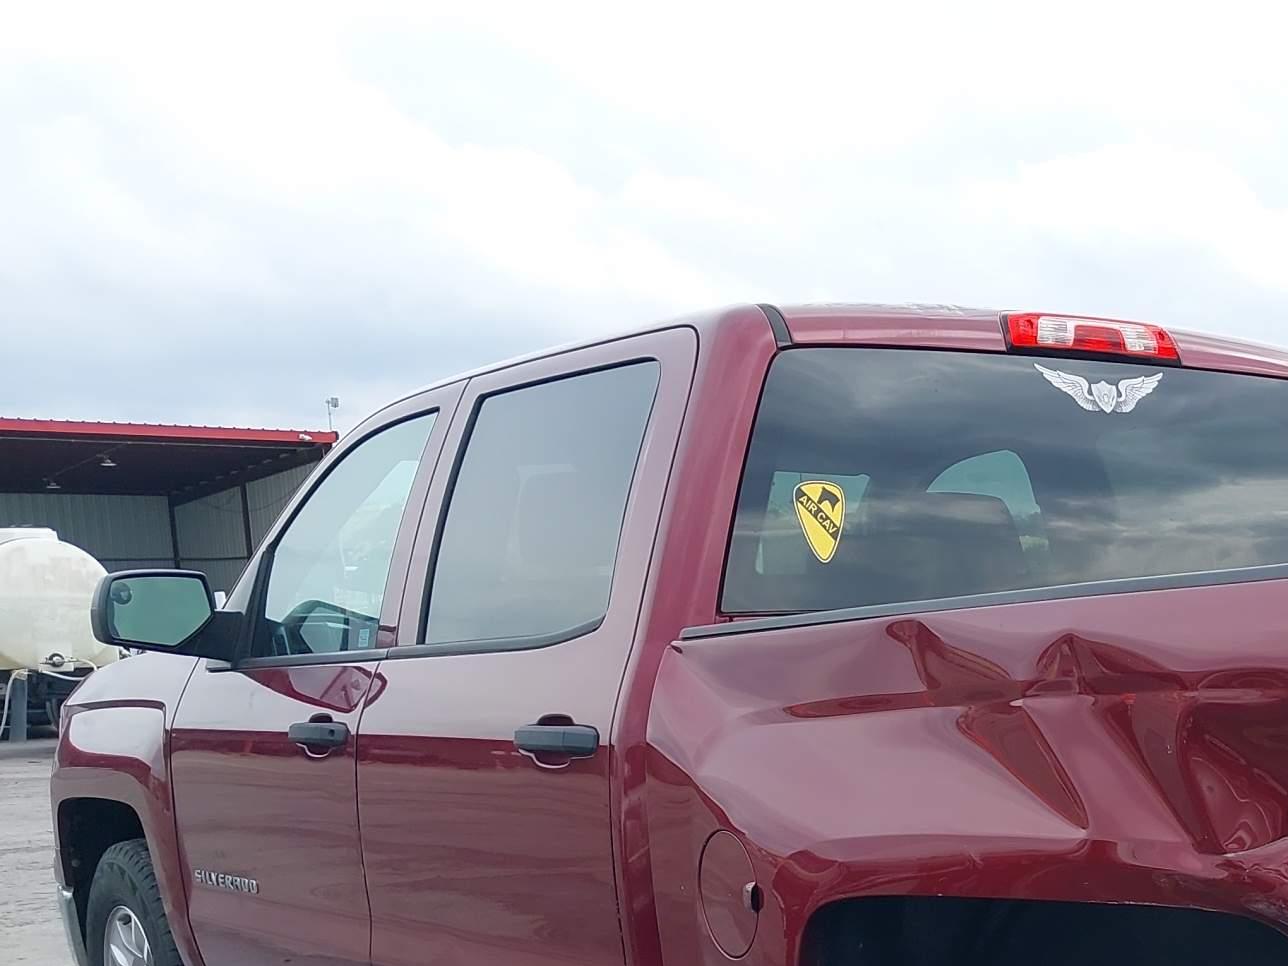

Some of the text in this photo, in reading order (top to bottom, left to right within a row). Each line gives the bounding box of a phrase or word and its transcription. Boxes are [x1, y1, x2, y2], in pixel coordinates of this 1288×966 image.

[798, 495, 838, 534] AIR CAV
[194, 869, 259, 894] SILVERADO
